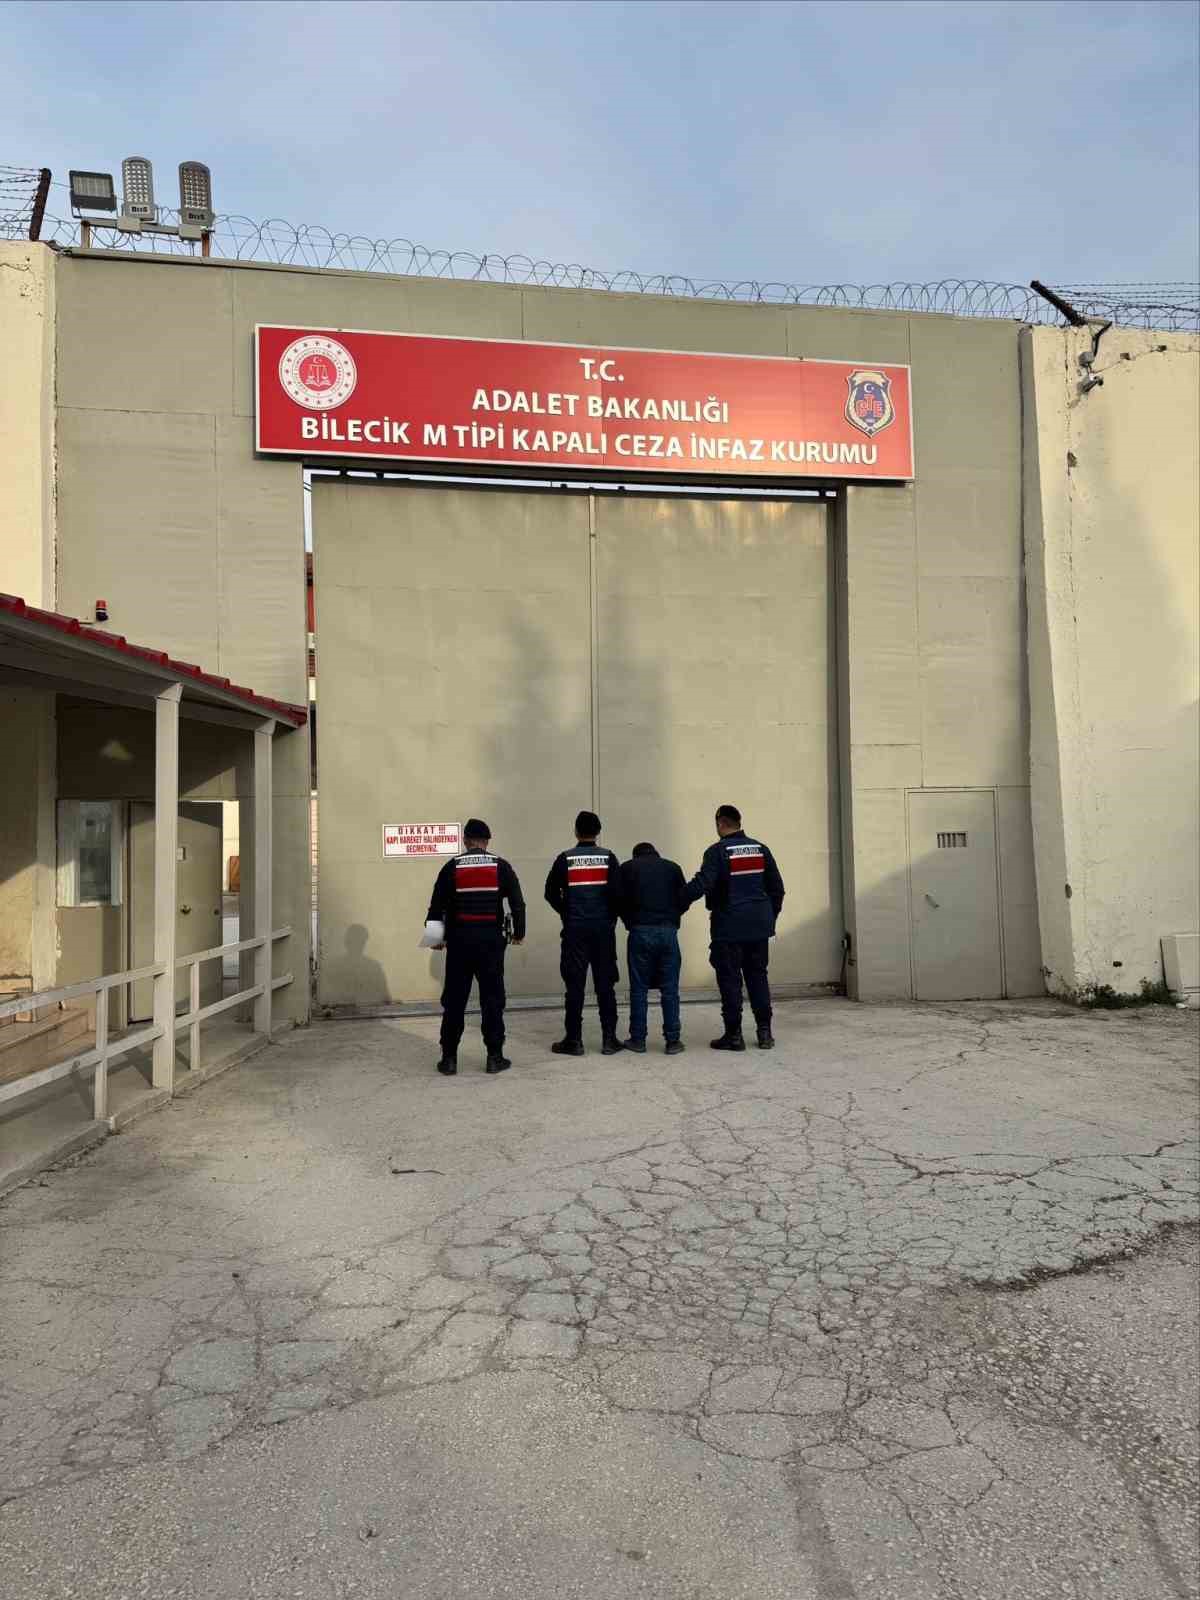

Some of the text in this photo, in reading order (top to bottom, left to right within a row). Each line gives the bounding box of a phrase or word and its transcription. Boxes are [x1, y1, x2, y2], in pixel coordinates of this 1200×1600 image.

[579, 358, 625, 382] T.C.
[472, 388, 729, 424] ADALET BAKANLIĞI
[301, 412, 878, 465] BİLECİK M TİPİ KAPALI CEZA İNFAZ KURUMU
